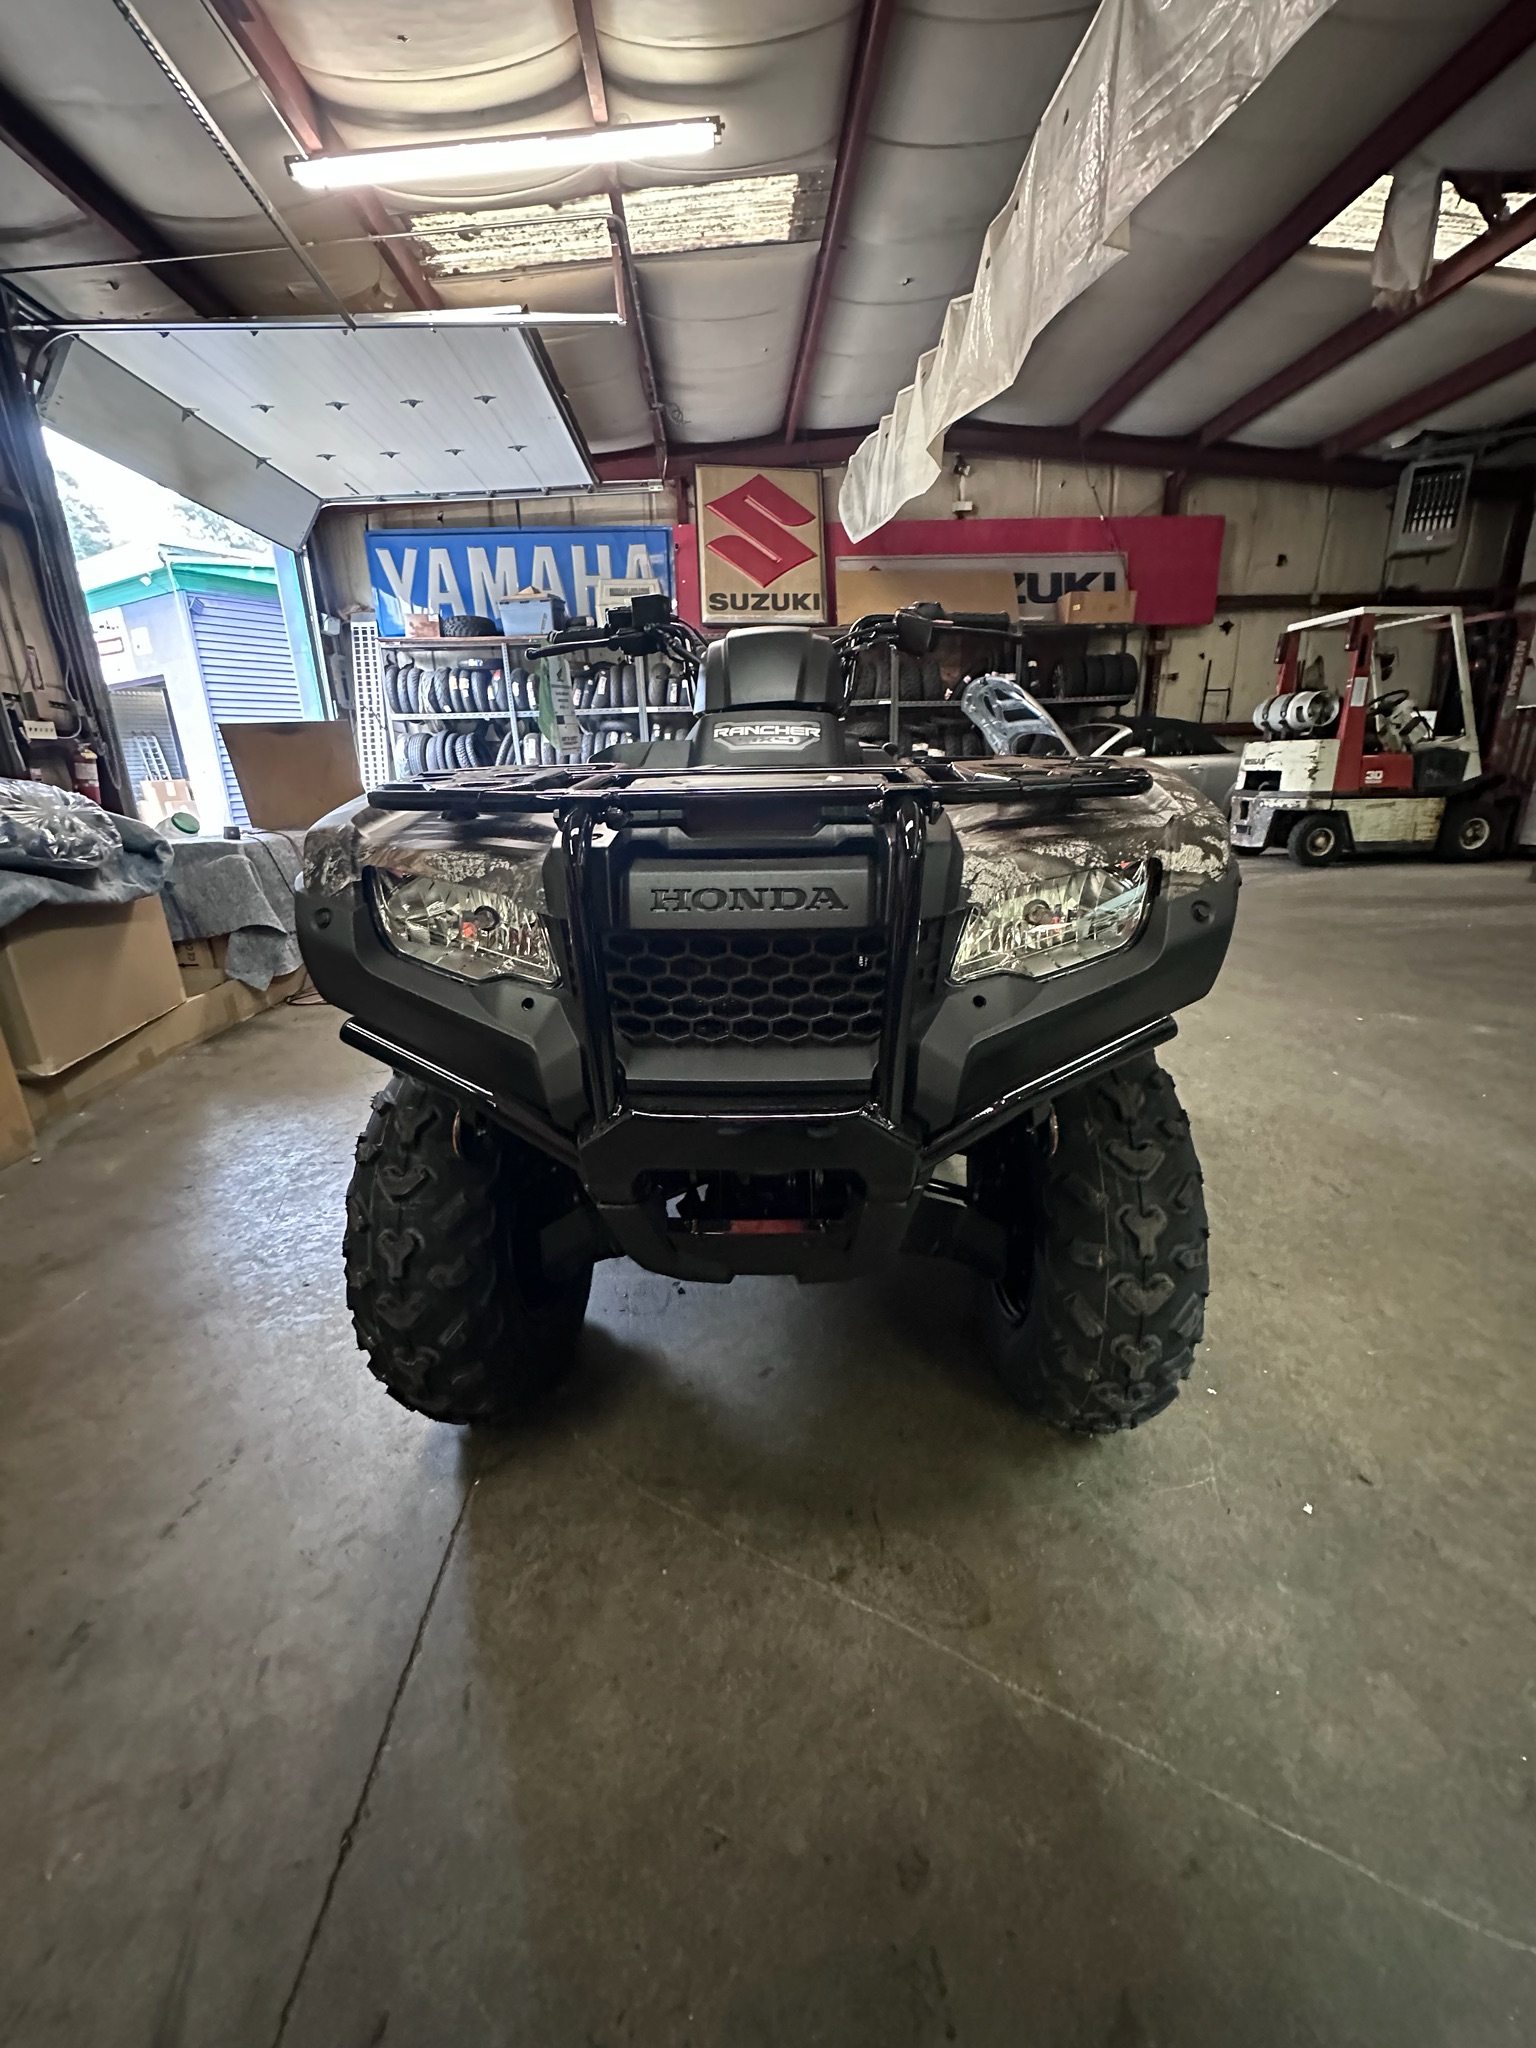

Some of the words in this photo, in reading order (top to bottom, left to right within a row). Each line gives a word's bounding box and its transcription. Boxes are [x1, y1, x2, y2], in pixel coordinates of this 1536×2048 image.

[708, 592, 821, 611] SUZUKI
[713, 725, 821, 738] RANCHER
[1365, 770, 1384, 780] 30
[650, 887, 849, 912] HONDA
